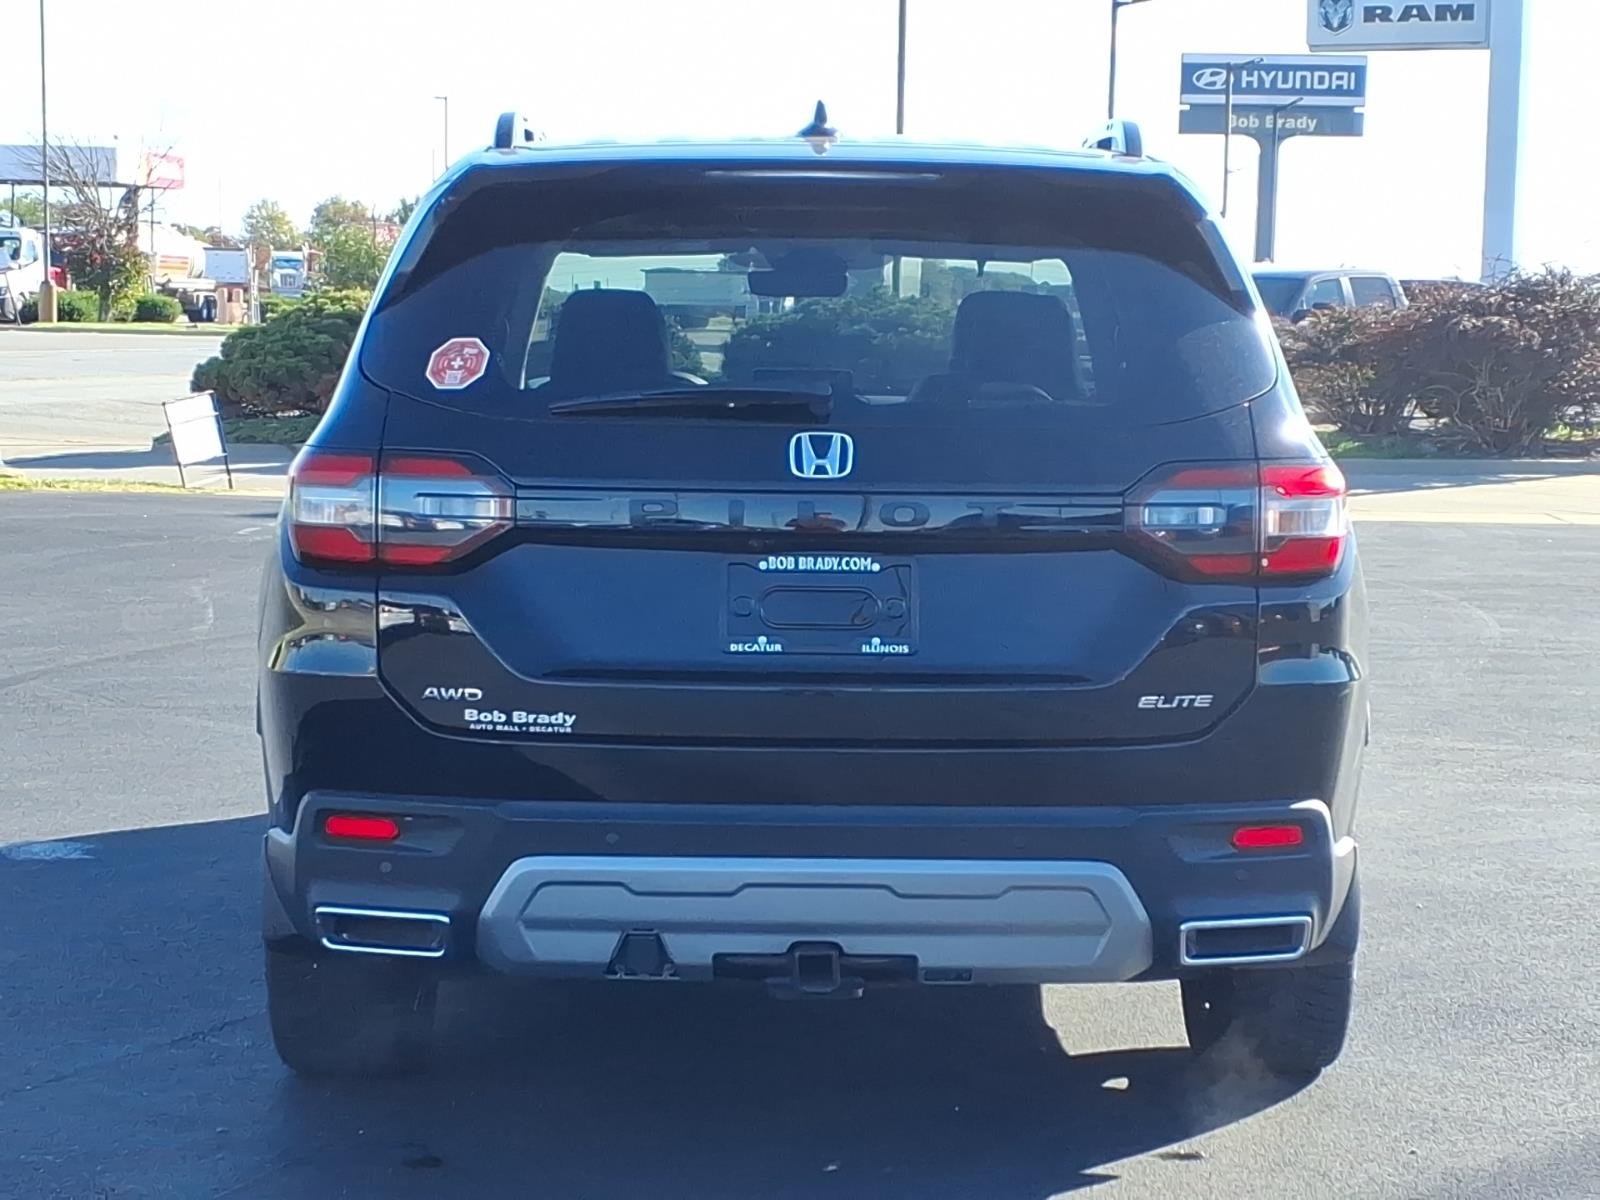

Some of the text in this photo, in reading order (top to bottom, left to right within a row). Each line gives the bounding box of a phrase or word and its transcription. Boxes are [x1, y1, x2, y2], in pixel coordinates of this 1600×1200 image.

[1363, 4, 1475, 24] RAM
[1241, 70, 1356, 91] HYUNDAI
[629, 499, 1014, 530] PILOT
[767, 556, 872, 572] BOB BRADY.COM
[729, 643, 910, 654] DECATUR ILLINOIS
[422, 687, 483, 701] AWD
[1138, 695, 1213, 708] ELITE
[463, 708, 576, 725] Bob Brady
[469, 723, 494, 731] AUTO
